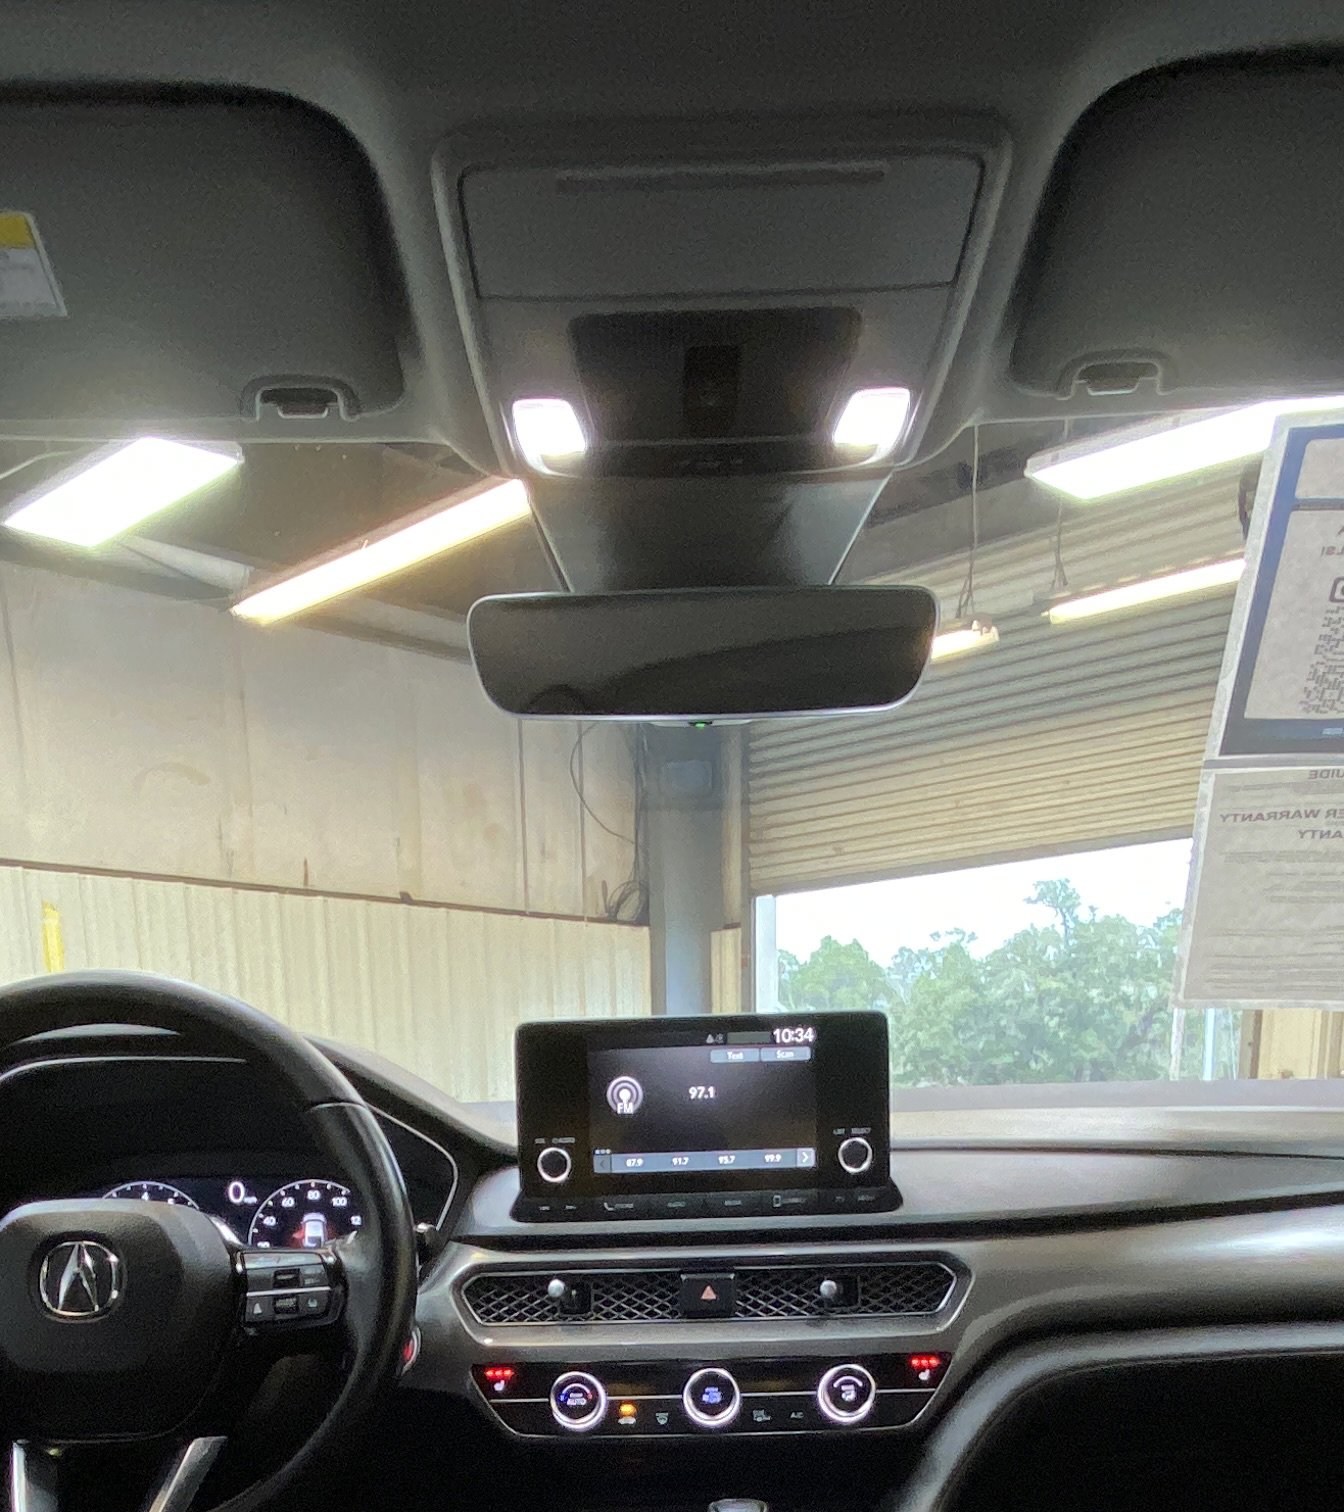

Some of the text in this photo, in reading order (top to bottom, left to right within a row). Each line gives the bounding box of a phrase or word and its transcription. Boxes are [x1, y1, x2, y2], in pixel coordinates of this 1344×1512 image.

[773, 1027, 815, 1044] 10:34
[688, 1086, 716, 1100] 97.1
[617, 1102, 634, 1114] FM
[228, 1181, 245, 1204] 0
[307, 1190, 320, 1201] 80
[281, 1196, 295, 1208] 60
[332, 1196, 347, 1208] 100
[263, 1215, 277, 1227] 40
